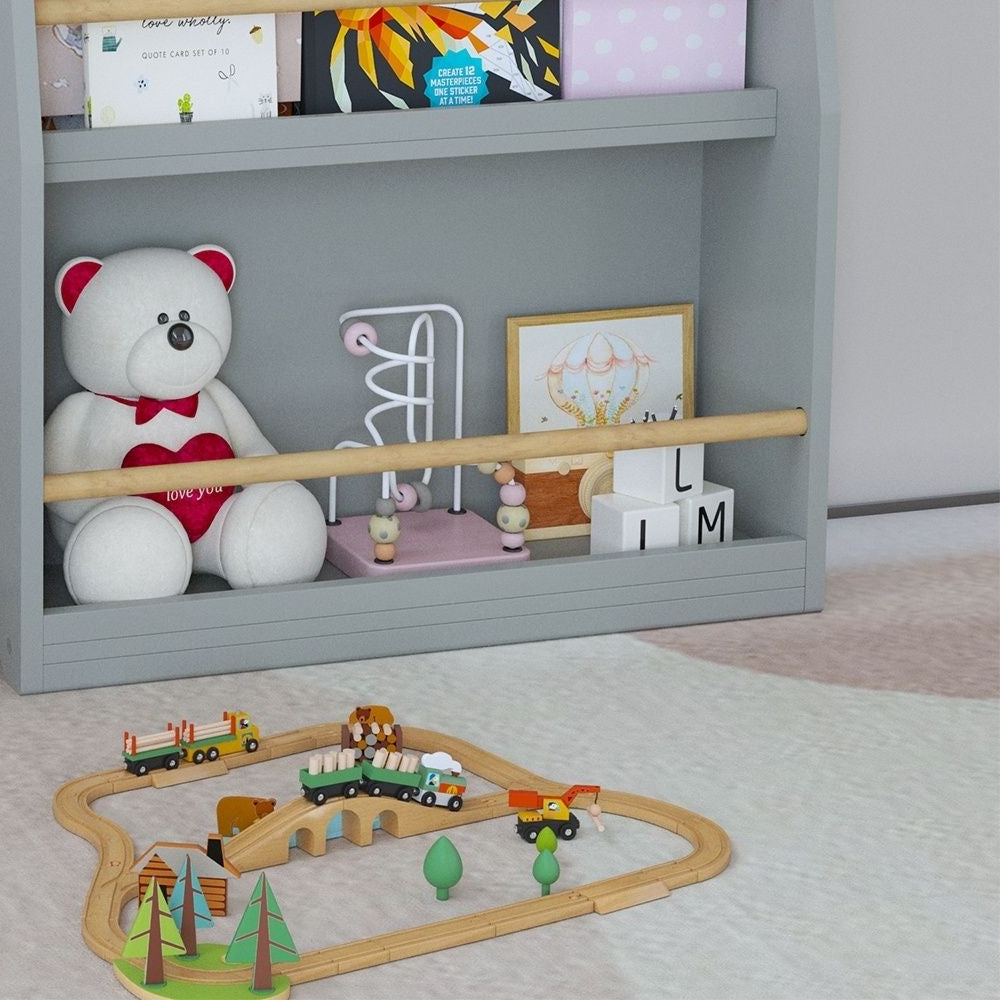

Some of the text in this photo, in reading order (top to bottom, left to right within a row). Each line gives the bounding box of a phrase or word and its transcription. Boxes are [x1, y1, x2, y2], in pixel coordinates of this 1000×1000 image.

[141, 48, 230, 60] QUOTE CARD SET OF 10
[438, 66, 475, 77] CREATE 12
[430, 76, 482, 87] MASTERPIECES
[434, 86, 478, 97] ONE STICKER
[440, 96, 448, 106] AT
[448, 96, 454, 105] A
[675, 447, 692, 493] L
[166, 486, 223, 502] love you
[697, 501, 726, 545] M
